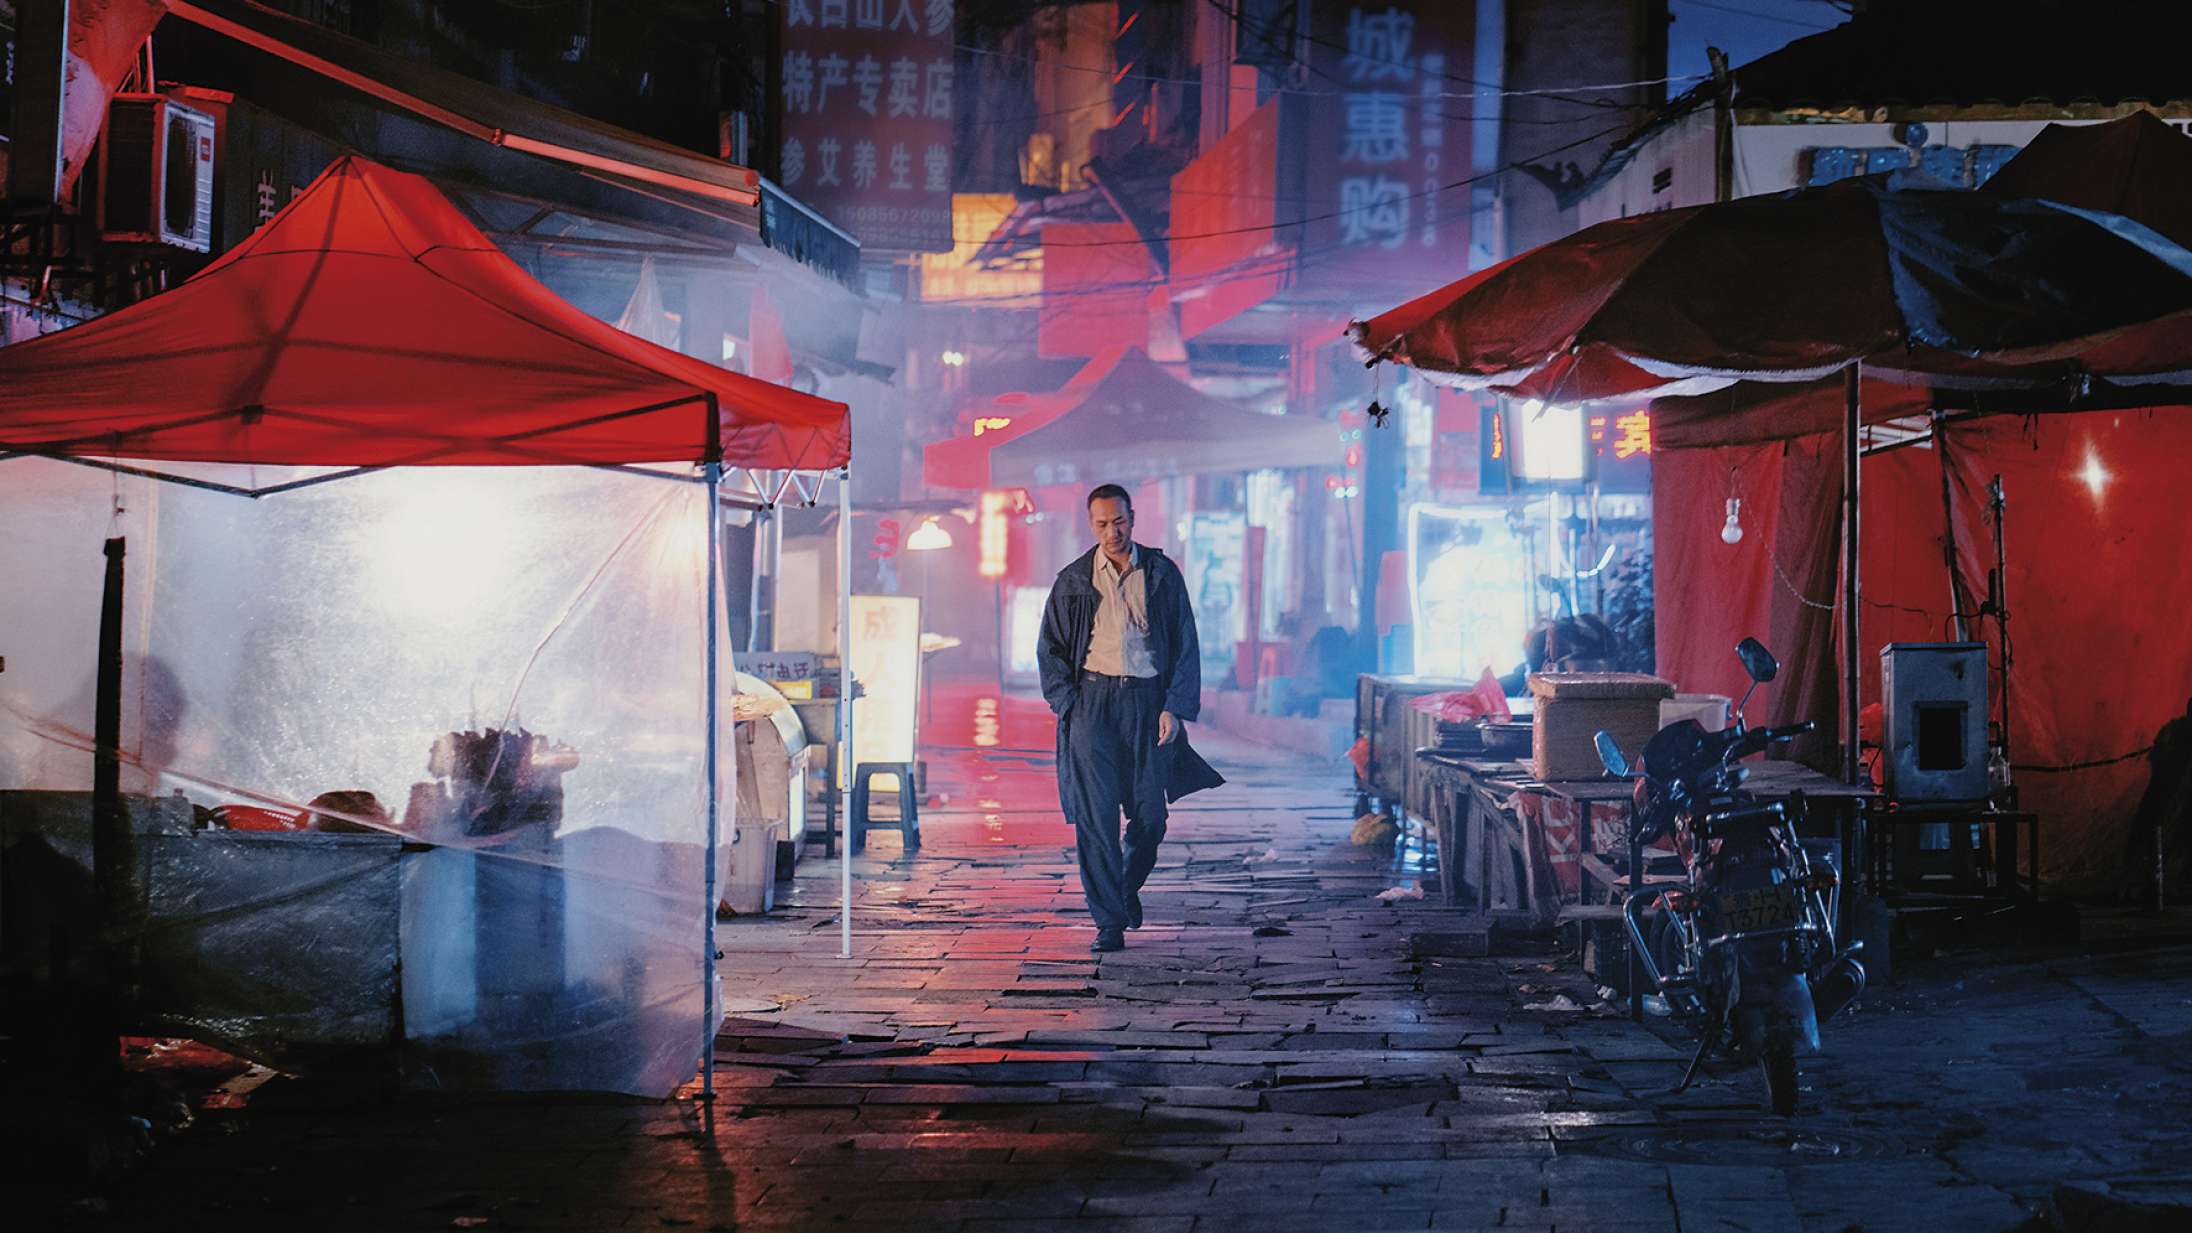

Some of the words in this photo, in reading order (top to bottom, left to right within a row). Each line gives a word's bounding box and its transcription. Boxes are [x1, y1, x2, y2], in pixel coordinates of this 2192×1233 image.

[781, 49, 955, 120] 特产专卖店
[781, 136, 949, 192] 参艾养生堂
[1339, 8, 1414, 250] 城惠购
